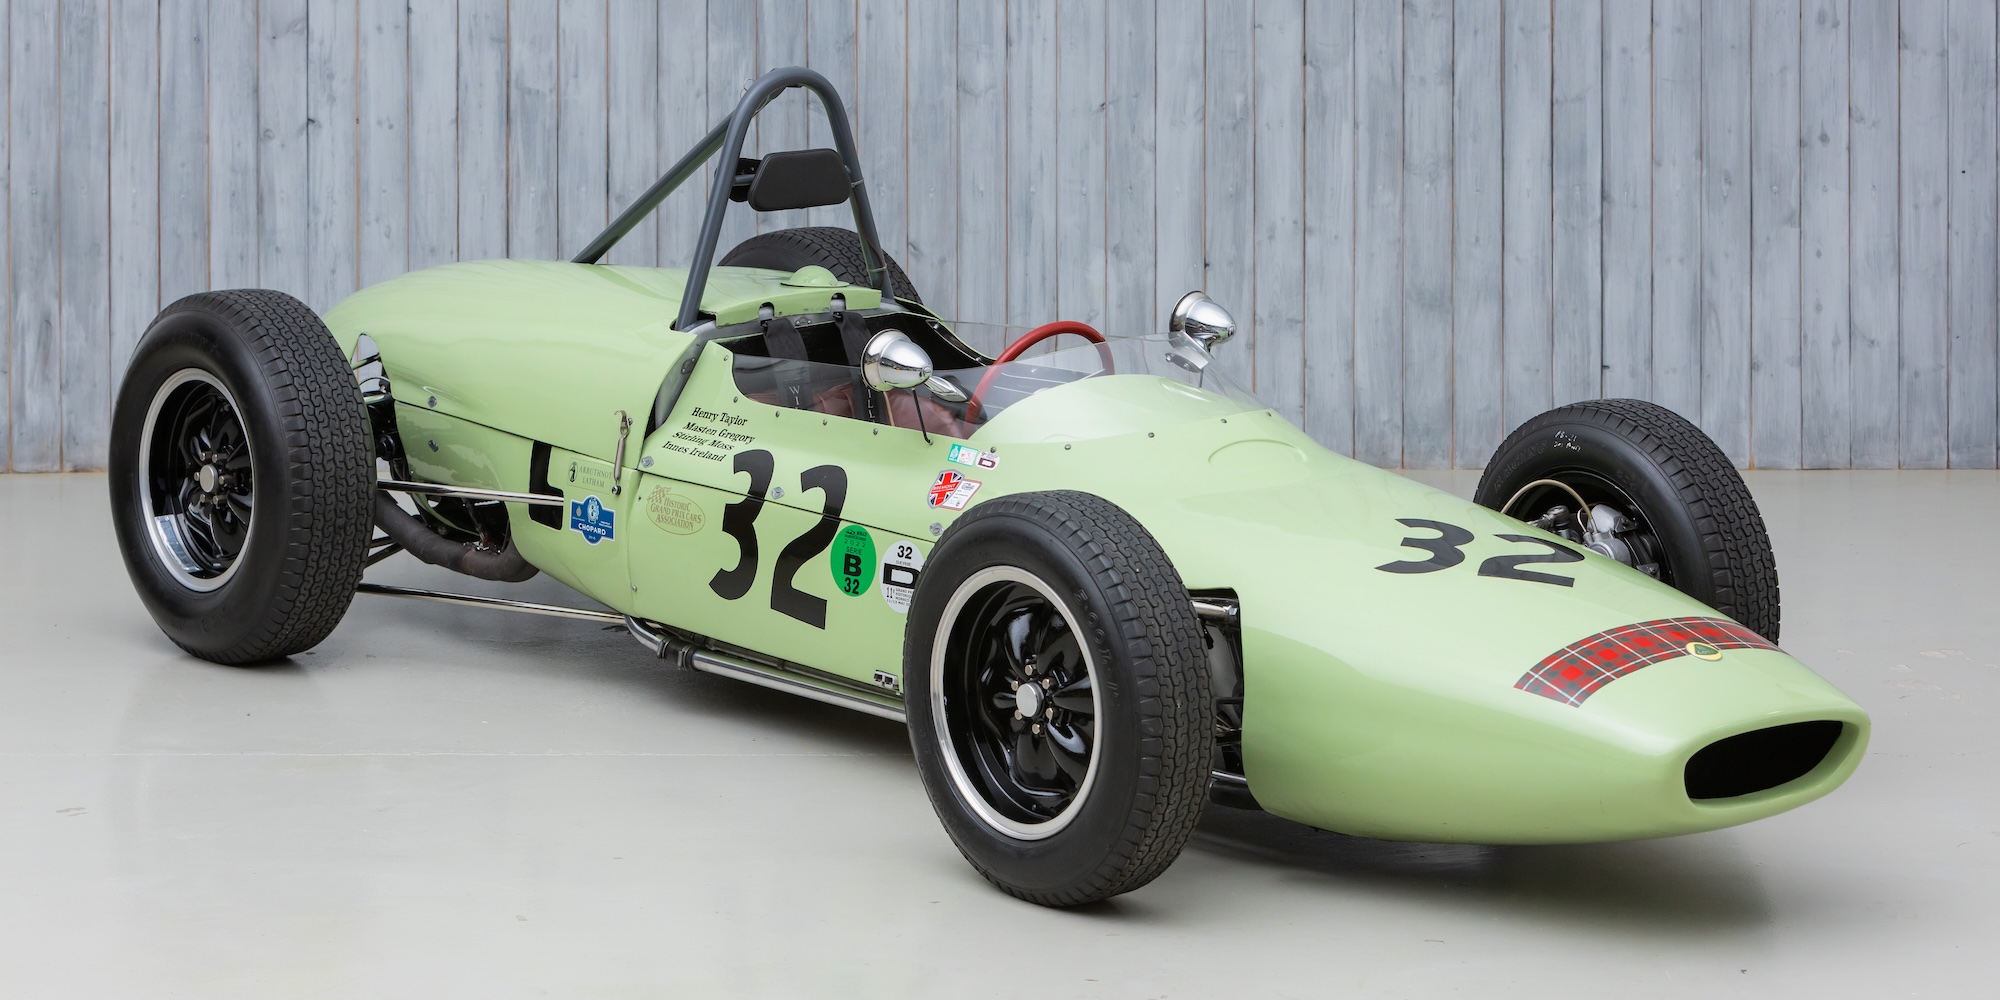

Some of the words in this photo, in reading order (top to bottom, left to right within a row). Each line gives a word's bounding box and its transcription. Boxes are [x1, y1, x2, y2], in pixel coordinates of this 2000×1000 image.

[691, 406, 719, 423] Henry
[719, 412, 748, 426] Taylor
[672, 431, 710, 446] Stirling
[707, 439, 735, 451] Moss
[682, 421, 717, 436] Masten
[718, 428, 756, 445] Gregory
[661, 440, 690, 454] Innes
[689, 447, 727, 462] Ireland
[578, 465, 613, 480] ARBUTHNOT
[582, 476, 605, 488] LATHAM
[650, 502, 671, 516] GRAND
[671, 508, 686, 520] PRIX
[685, 512, 702, 524] CARS
[664, 496, 692, 512] HISTORIC
[578, 522, 607, 536] CHOPARD
[656, 513, 694, 531] ASSOCIATION
[709, 449, 847, 630] 32
[844, 538, 866, 549] 2022
[897, 545, 913, 560] 32
[1374, 518, 1585, 588] 32
[844, 553, 862, 577] B
[844, 576, 860, 595] 32
[882, 562, 921, 590] D
